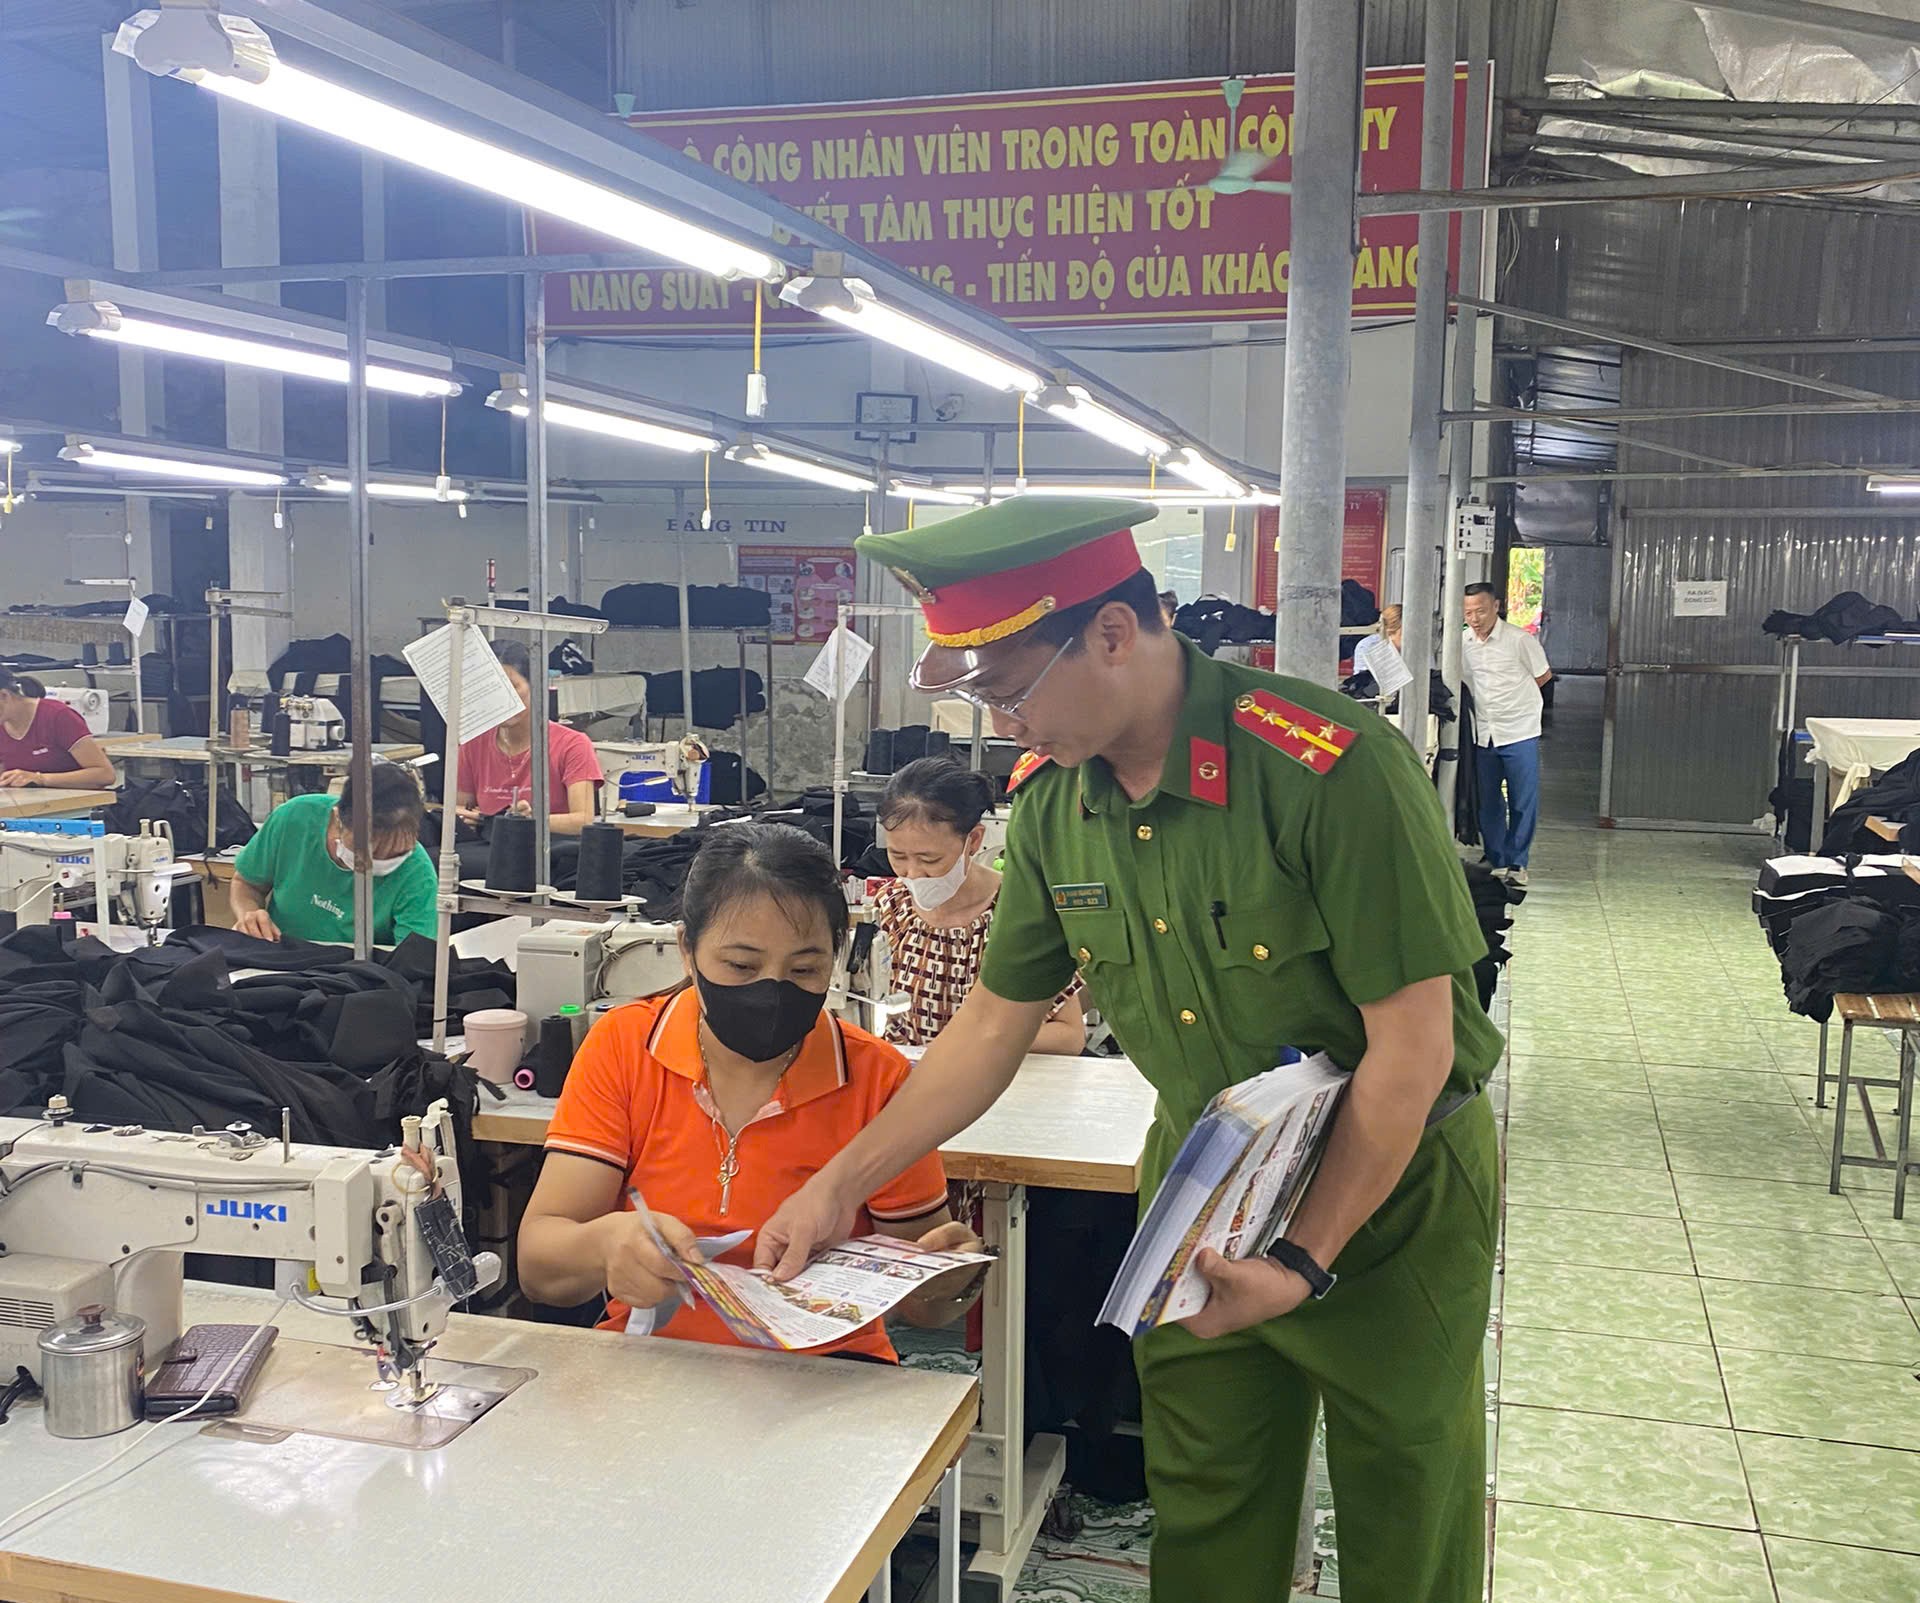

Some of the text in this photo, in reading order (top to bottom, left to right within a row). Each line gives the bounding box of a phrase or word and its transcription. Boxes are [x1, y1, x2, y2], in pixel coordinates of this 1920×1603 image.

[713, 134, 801, 182] CÔNG
[812, 129, 905, 180] NHÂN
[914, 123, 991, 175] VIÊN
[1002, 123, 1120, 171] TRONG
[1131, 110, 1225, 164] TOÀN
[1239, 105, 1294, 158] CÔ
[860, 194, 933, 243] TÂM
[943, 195, 1034, 249] THỰC
[1047, 184, 1133, 245] HIỆN
[1146, 173, 1215, 231] TỐT
[987, 248, 1056, 303] TIẾN
[1067, 249, 1115, 311] ĐỘ
[1126, 244, 1191, 299] CỦA
[744, 519, 787, 533] TIN
[55, 856, 90, 865] JUKI
[206, 1199, 287, 1222] JUKI
